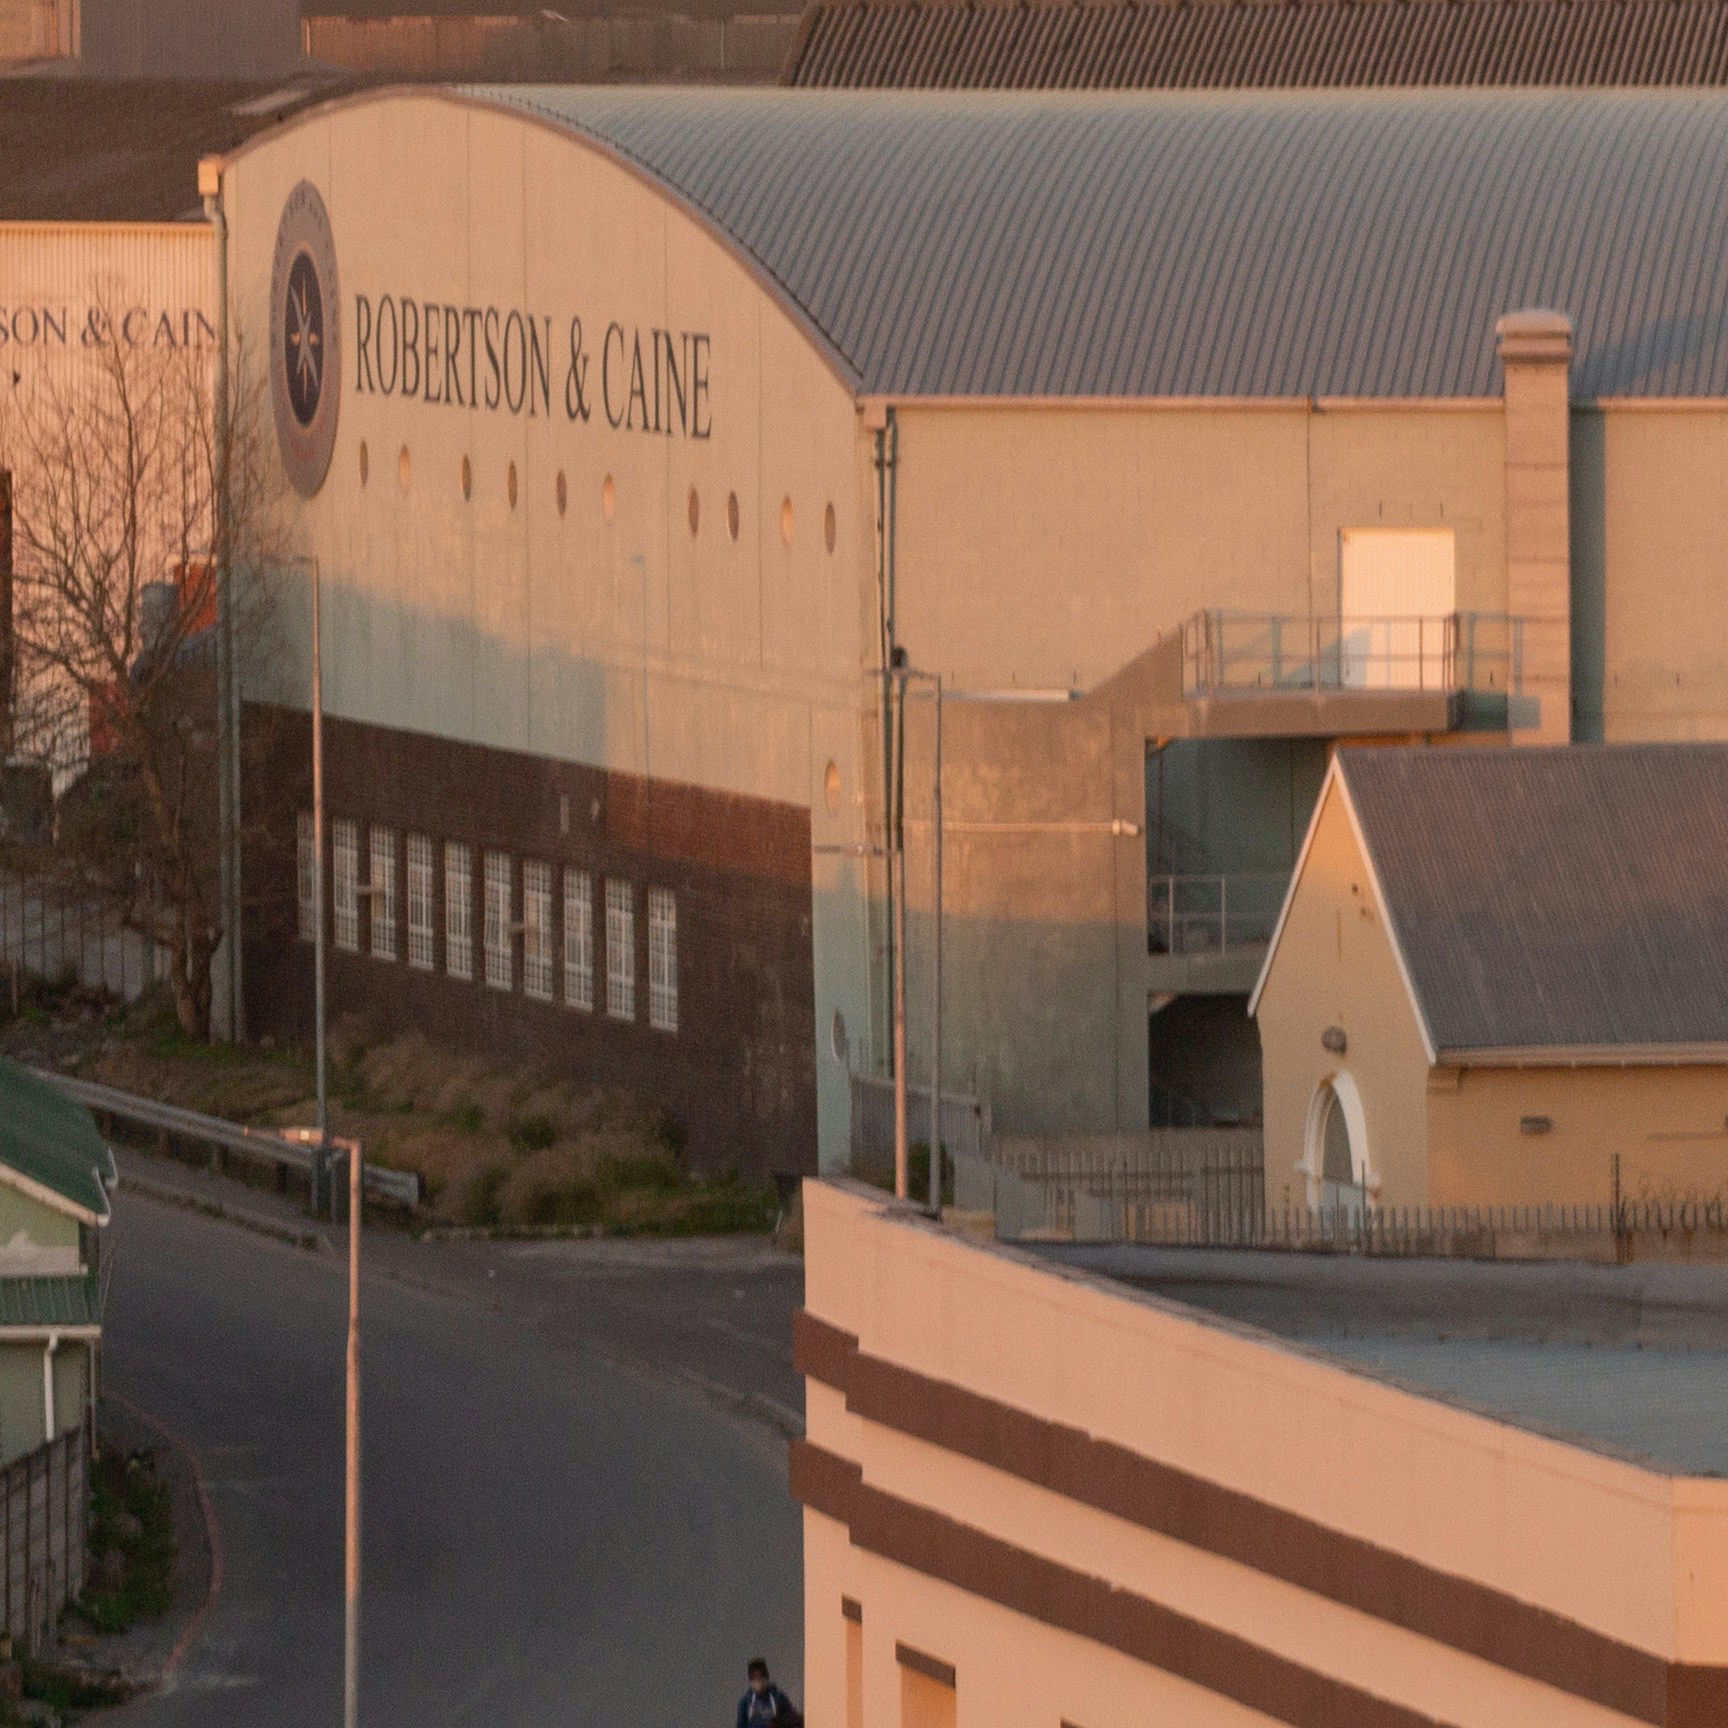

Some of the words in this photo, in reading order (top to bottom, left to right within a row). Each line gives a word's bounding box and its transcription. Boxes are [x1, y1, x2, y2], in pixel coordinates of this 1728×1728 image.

[80, 305, 111, 349] &
[122, 306, 217, 349] CAIN
[354, 293, 551, 420] ROBERTSON
[565, 315, 591, 425] &
[601, 320, 713, 440] CAINE
